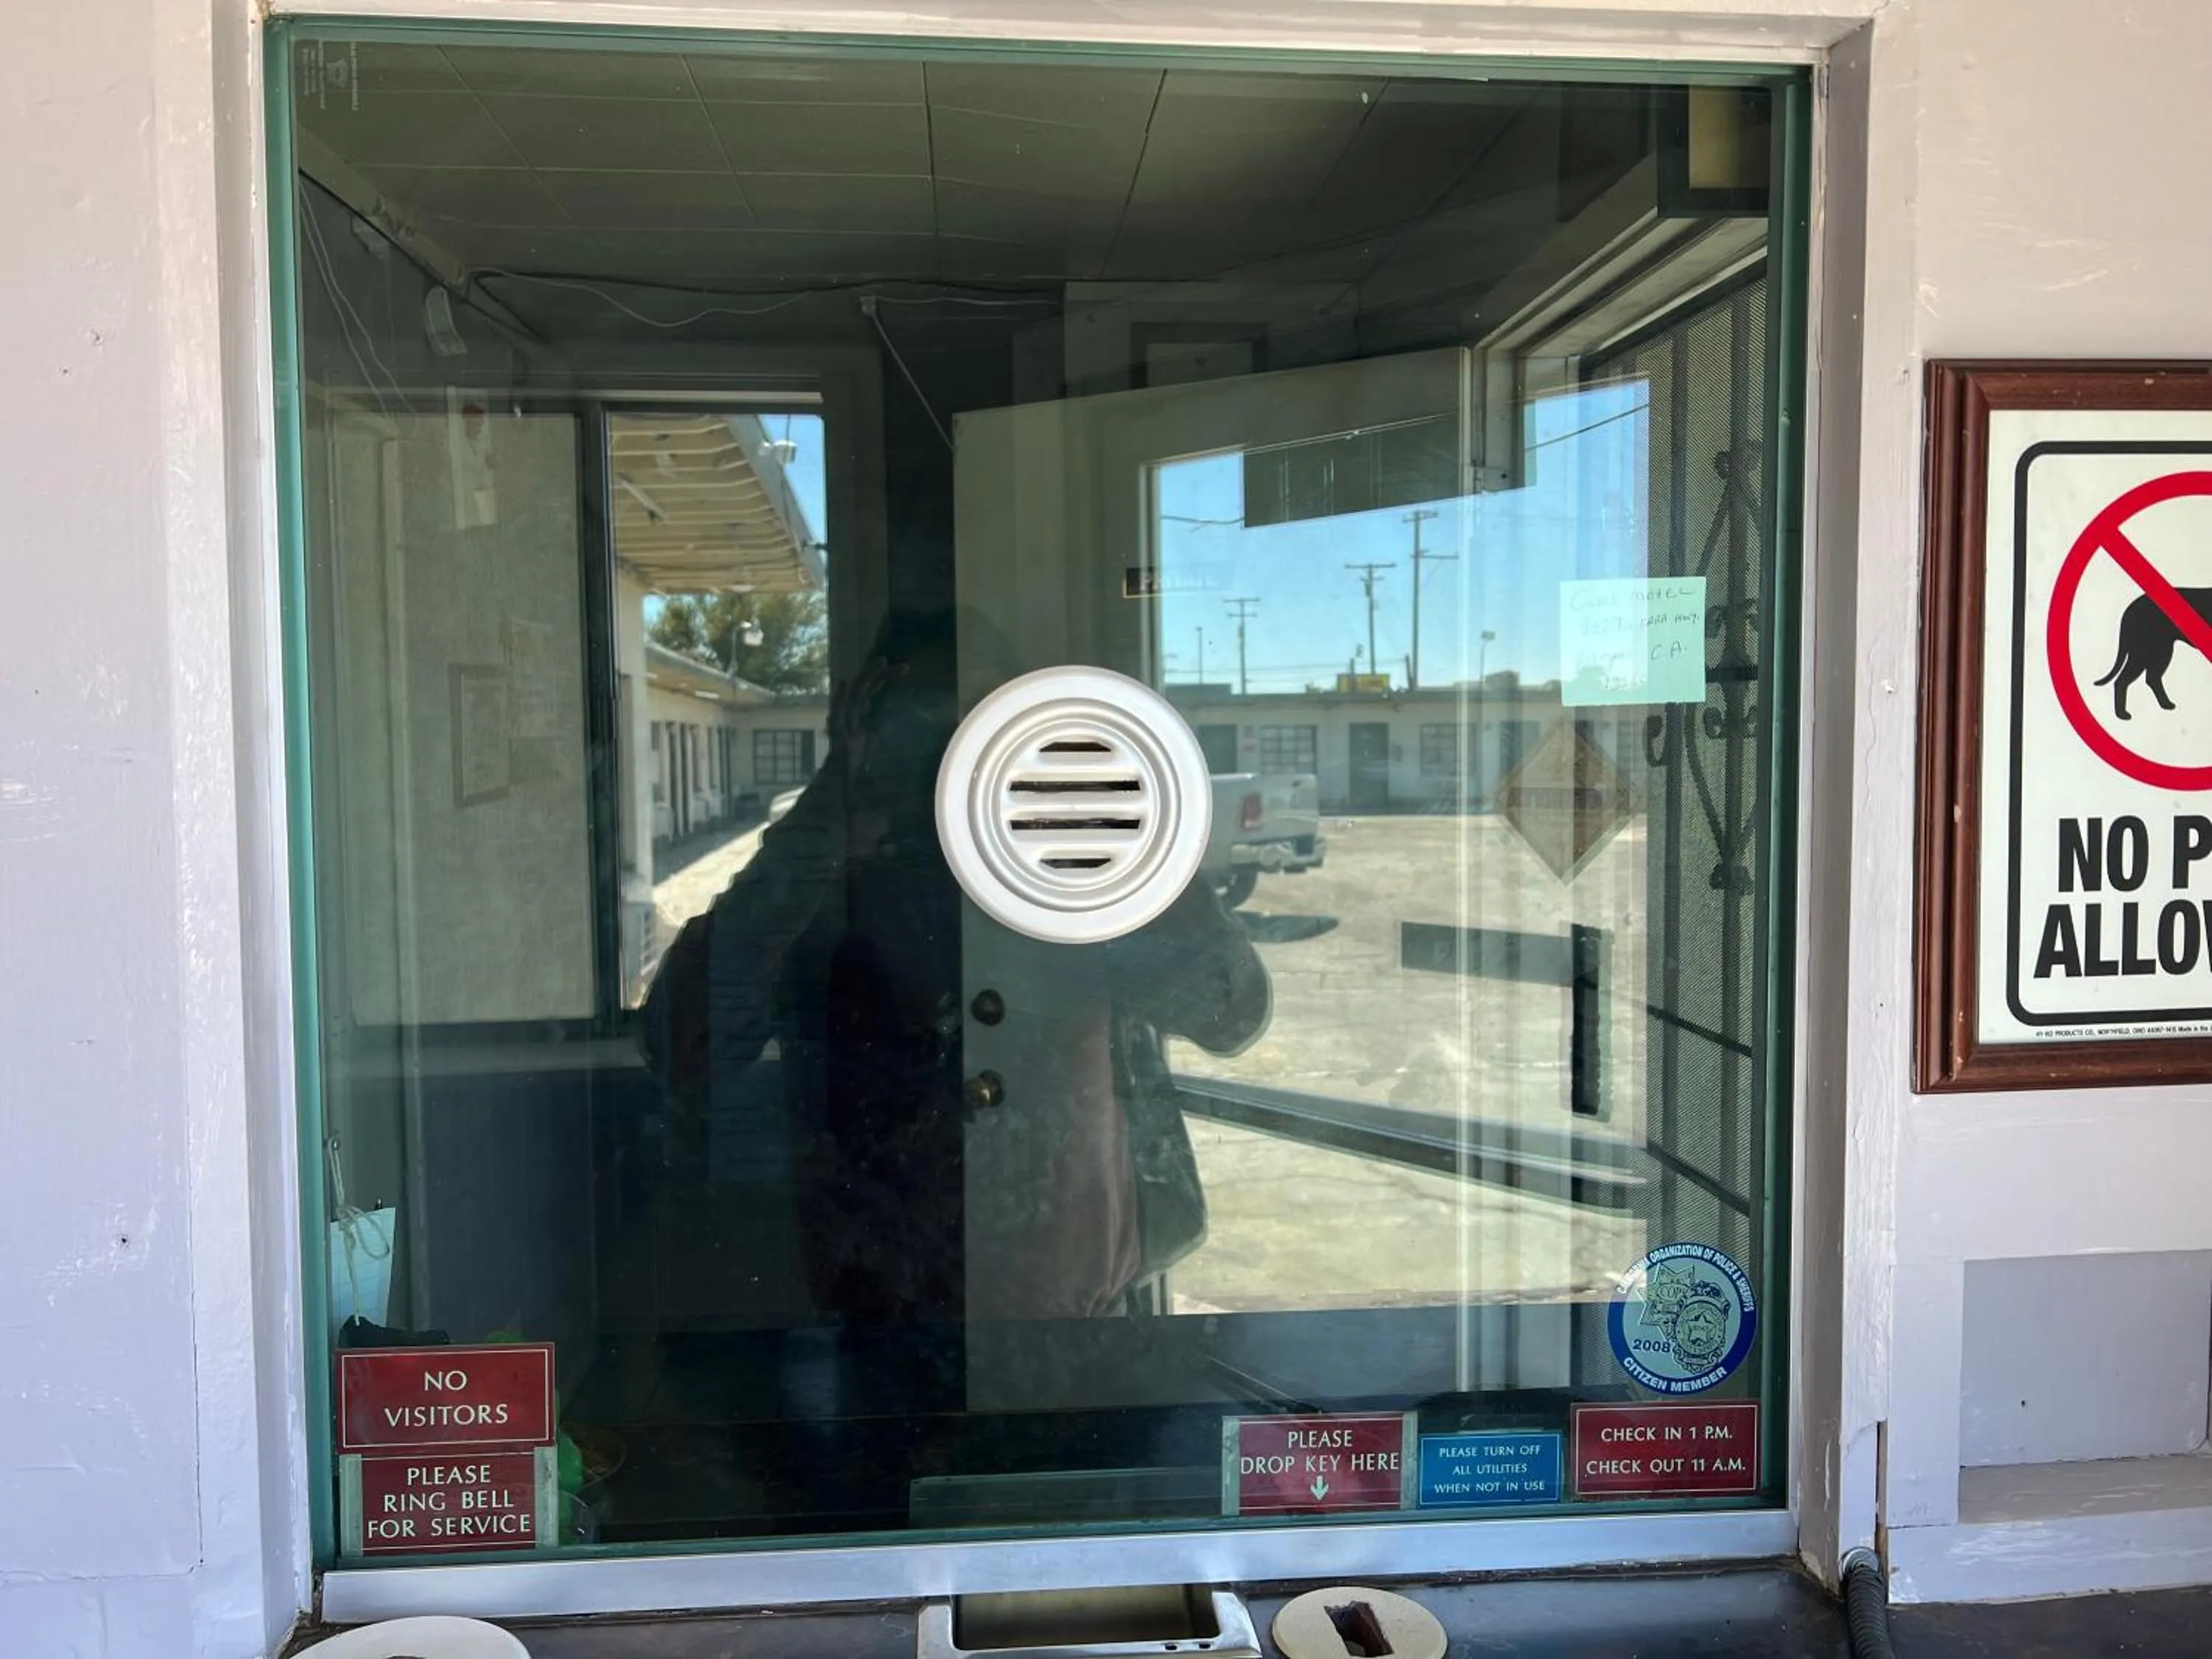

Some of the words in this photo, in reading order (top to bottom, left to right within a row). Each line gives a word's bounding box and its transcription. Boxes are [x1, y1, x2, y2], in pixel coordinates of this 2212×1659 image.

[2058, 815, 2149, 893] NO
[2033, 899, 2212, 978] ALLO
[1649, 1242, 1703, 1263] ORGANIZATION
[1703, 1248, 1715, 1259] OF
[1712, 1252, 1737, 1276] POLICE
[1632, 1338, 1671, 1354] 2008
[424, 1370, 467, 1391] NO
[1623, 1357, 1668, 1391] CITIZEN
[1670, 1366, 1728, 1393] MEMBER
[384, 1403, 509, 1427] VISITORS
[1287, 1429, 1354, 1449] PLEASE
[1600, 1426, 1656, 1442] CHECK
[1664, 1426, 1683, 1440] IN
[1688, 1426, 1697, 1439] 1
[1704, 1424, 1733, 1439] P.M.
[1439, 1445, 1478, 1458] PLEASE
[1483, 1446, 1514, 1457] TURN
[1519, 1444, 1542, 1455] OFF
[1240, 1455, 1295, 1475] DROP
[1305, 1453, 1342, 1473] KEY
[1351, 1452, 1399, 1472] HERE
[1452, 1464, 1472, 1475] ALL
[1477, 1463, 1528, 1475] UTILITIES
[1585, 1458, 1641, 1475] CHECK
[1649, 1458, 1685, 1473] OUT
[1690, 1457, 1705, 1472] 11
[1711, 1456, 1747, 1471] A.M.
[406, 1464, 492, 1486] PLEASE
[1434, 1482, 1470, 1494] WHEN
[1475, 1481, 1501, 1492] NOT
[1506, 1481, 1518, 1492] IN
[1523, 1480, 1545, 1491] USE
[383, 1492, 446, 1512] RING
[461, 1489, 515, 1509] BELL
[367, 1519, 416, 1539] FOR
[431, 1514, 532, 1536] SERVICE
